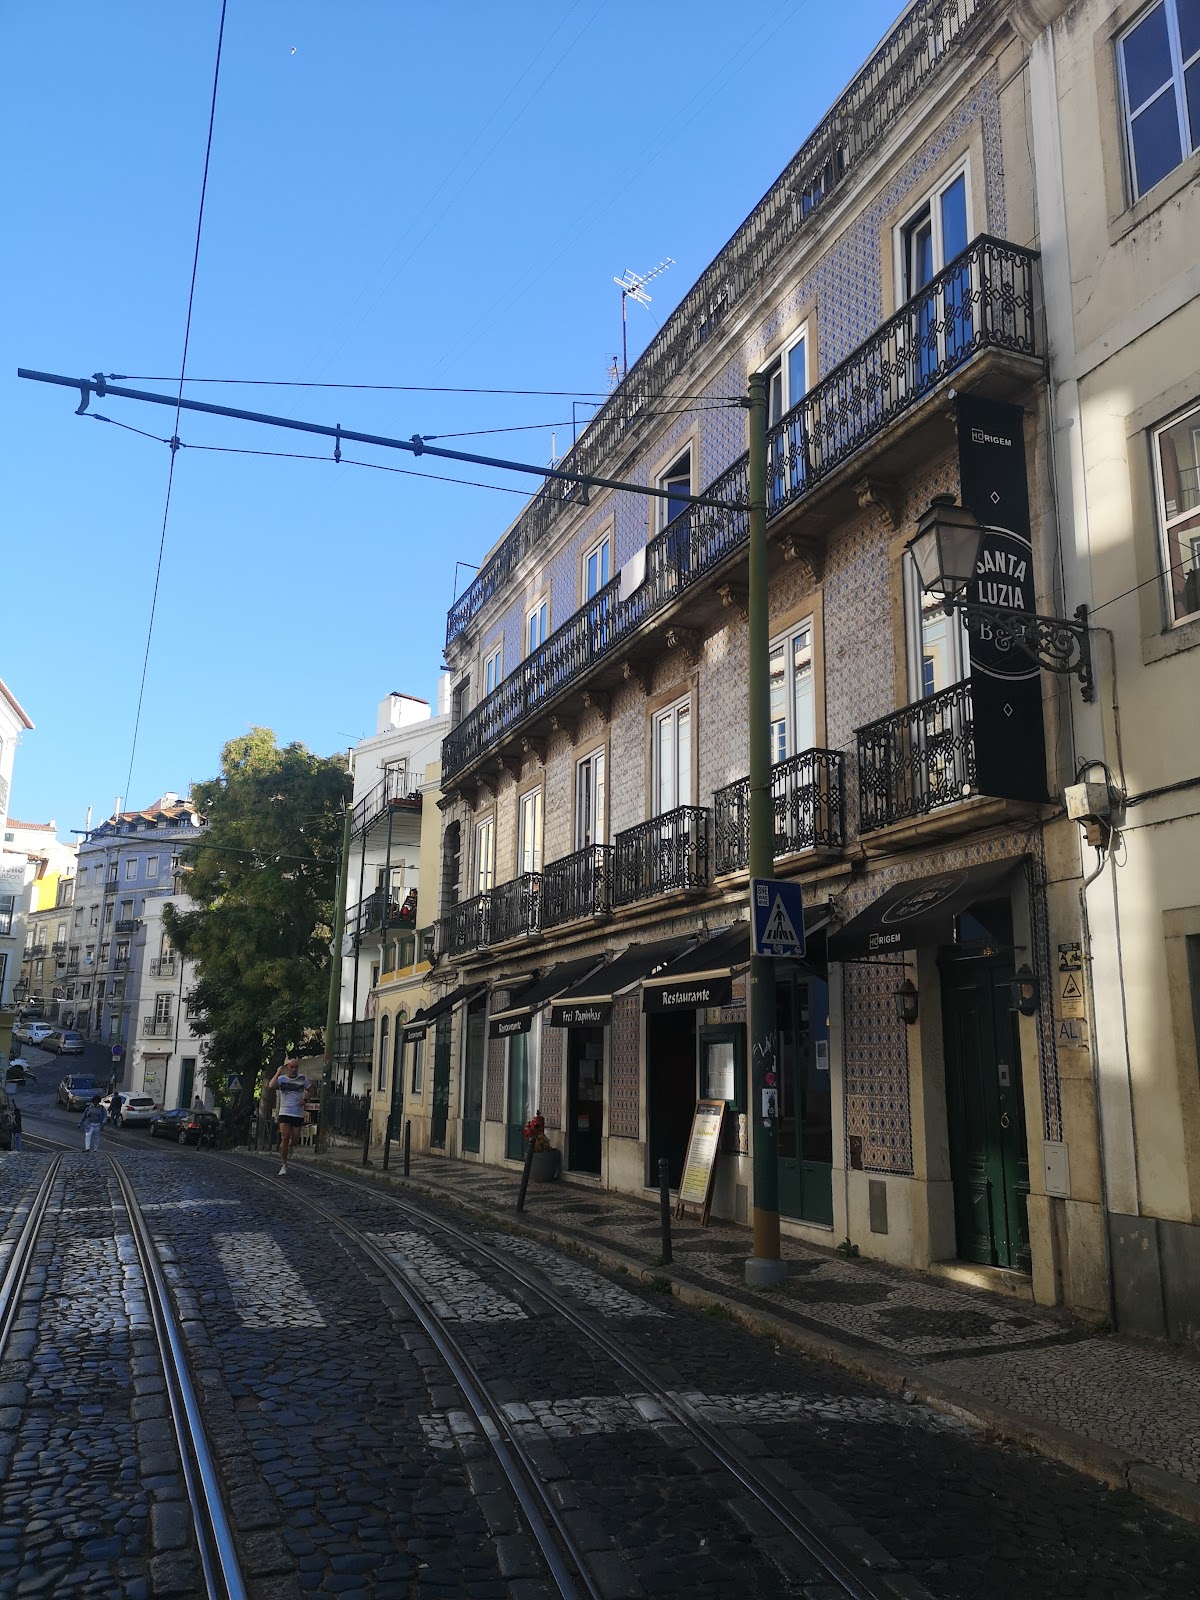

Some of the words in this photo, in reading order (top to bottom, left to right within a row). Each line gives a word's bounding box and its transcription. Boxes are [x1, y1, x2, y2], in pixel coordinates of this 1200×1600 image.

[978, 580, 1025, 610] LUZIA
[662, 988, 710, 1006] Restaurante
[562, 1010, 574, 1022] Frei
[575, 1007, 602, 1025] Papinhas
[1060, 1022, 1079, 1039] AL
